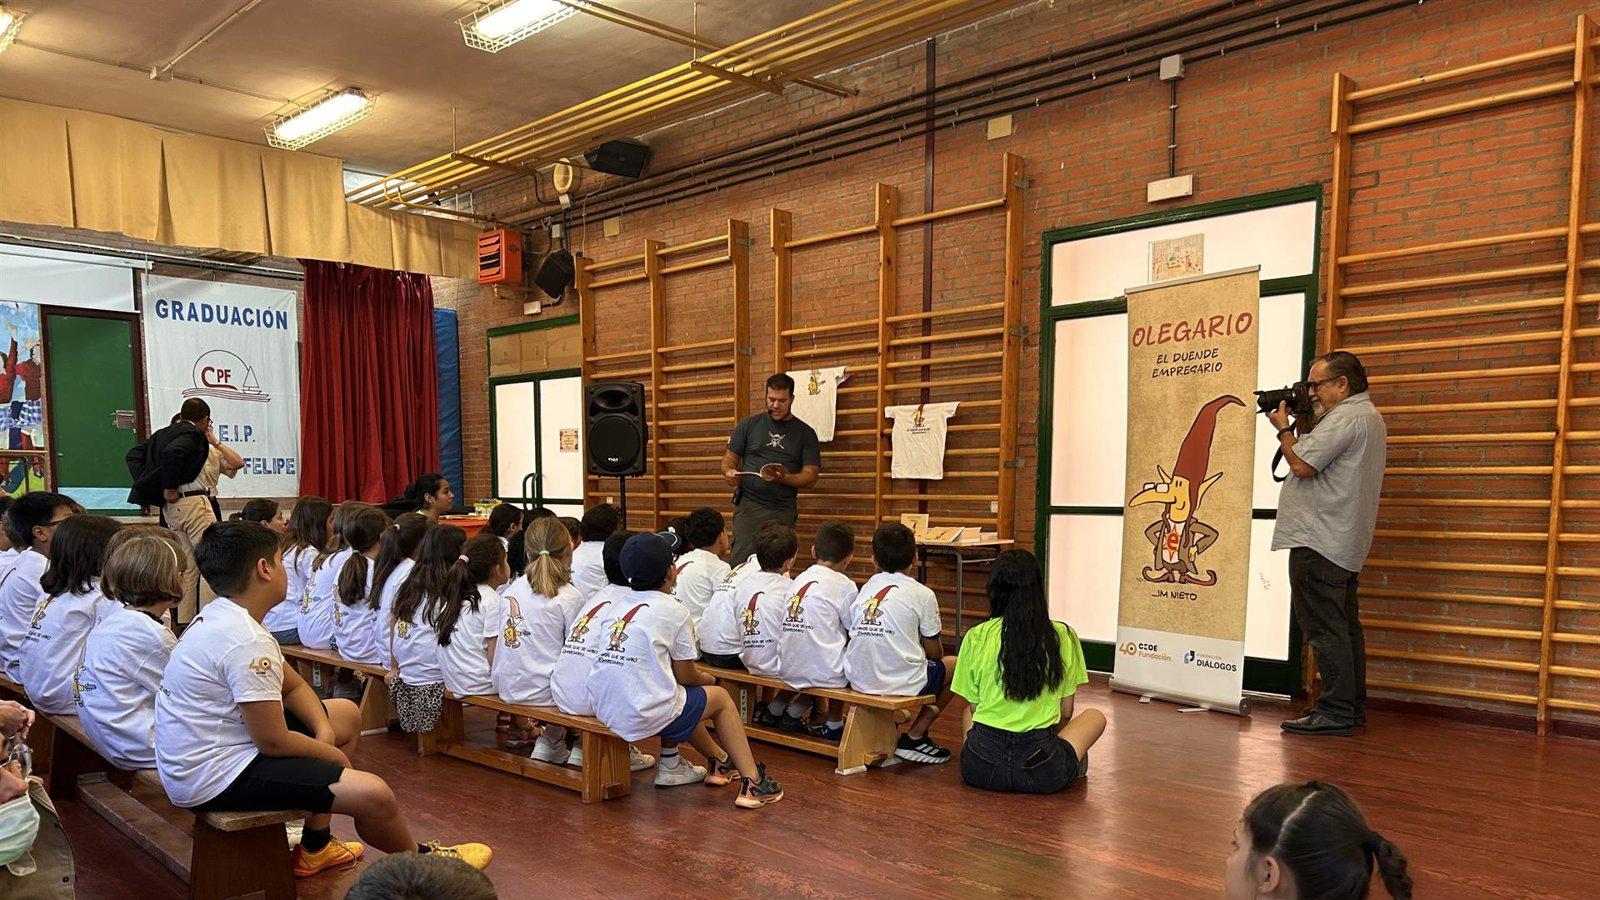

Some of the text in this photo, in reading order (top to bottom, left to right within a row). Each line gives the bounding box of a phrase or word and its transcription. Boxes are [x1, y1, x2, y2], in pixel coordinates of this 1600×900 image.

[155, 299, 288, 330] GRADUACIÓN
[1132, 312, 1252, 346] OLEGARIO
[1156, 348, 1219, 365] EL DUENDE
[201, 366, 238, 391] CPF
[1152, 362, 1223, 379] EMPRESARIO
[243, 457, 296, 475] FELIPE
[1170, 591, 1198, 601] NIETO
[1138, 651, 1172, 662] Fundación
